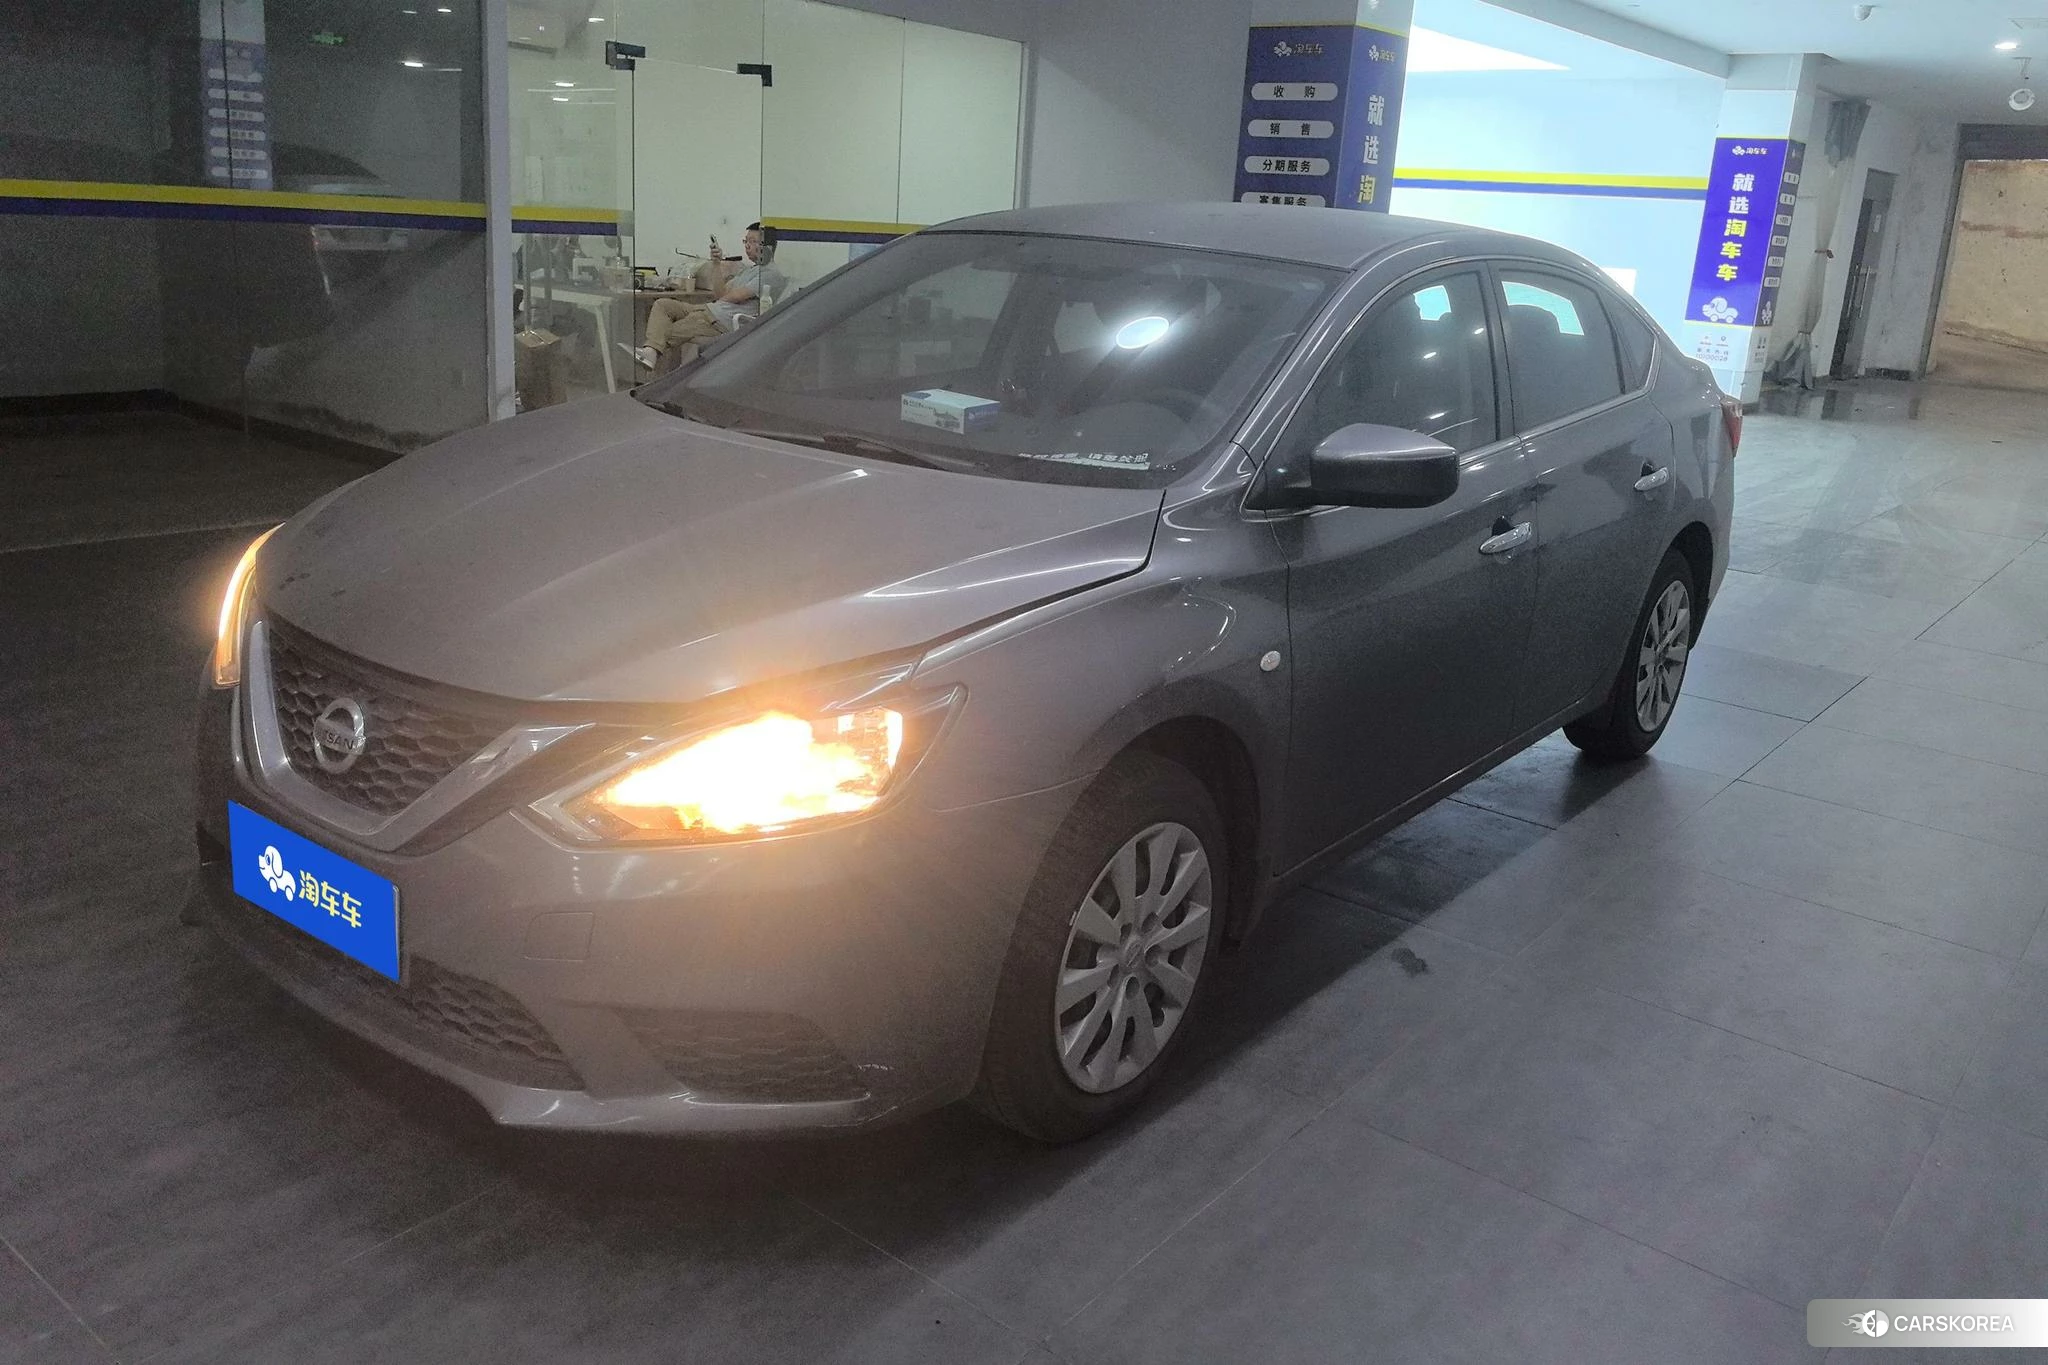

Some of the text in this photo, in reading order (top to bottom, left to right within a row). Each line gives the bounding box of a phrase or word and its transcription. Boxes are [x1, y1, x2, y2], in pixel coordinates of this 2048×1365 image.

[1273, 85, 1316, 98] 收购
[1269, 122, 1311, 136] 销售
[1262, 159, 1312, 173] 分期服务
[1716, 173, 1755, 281] 就选淘车车
